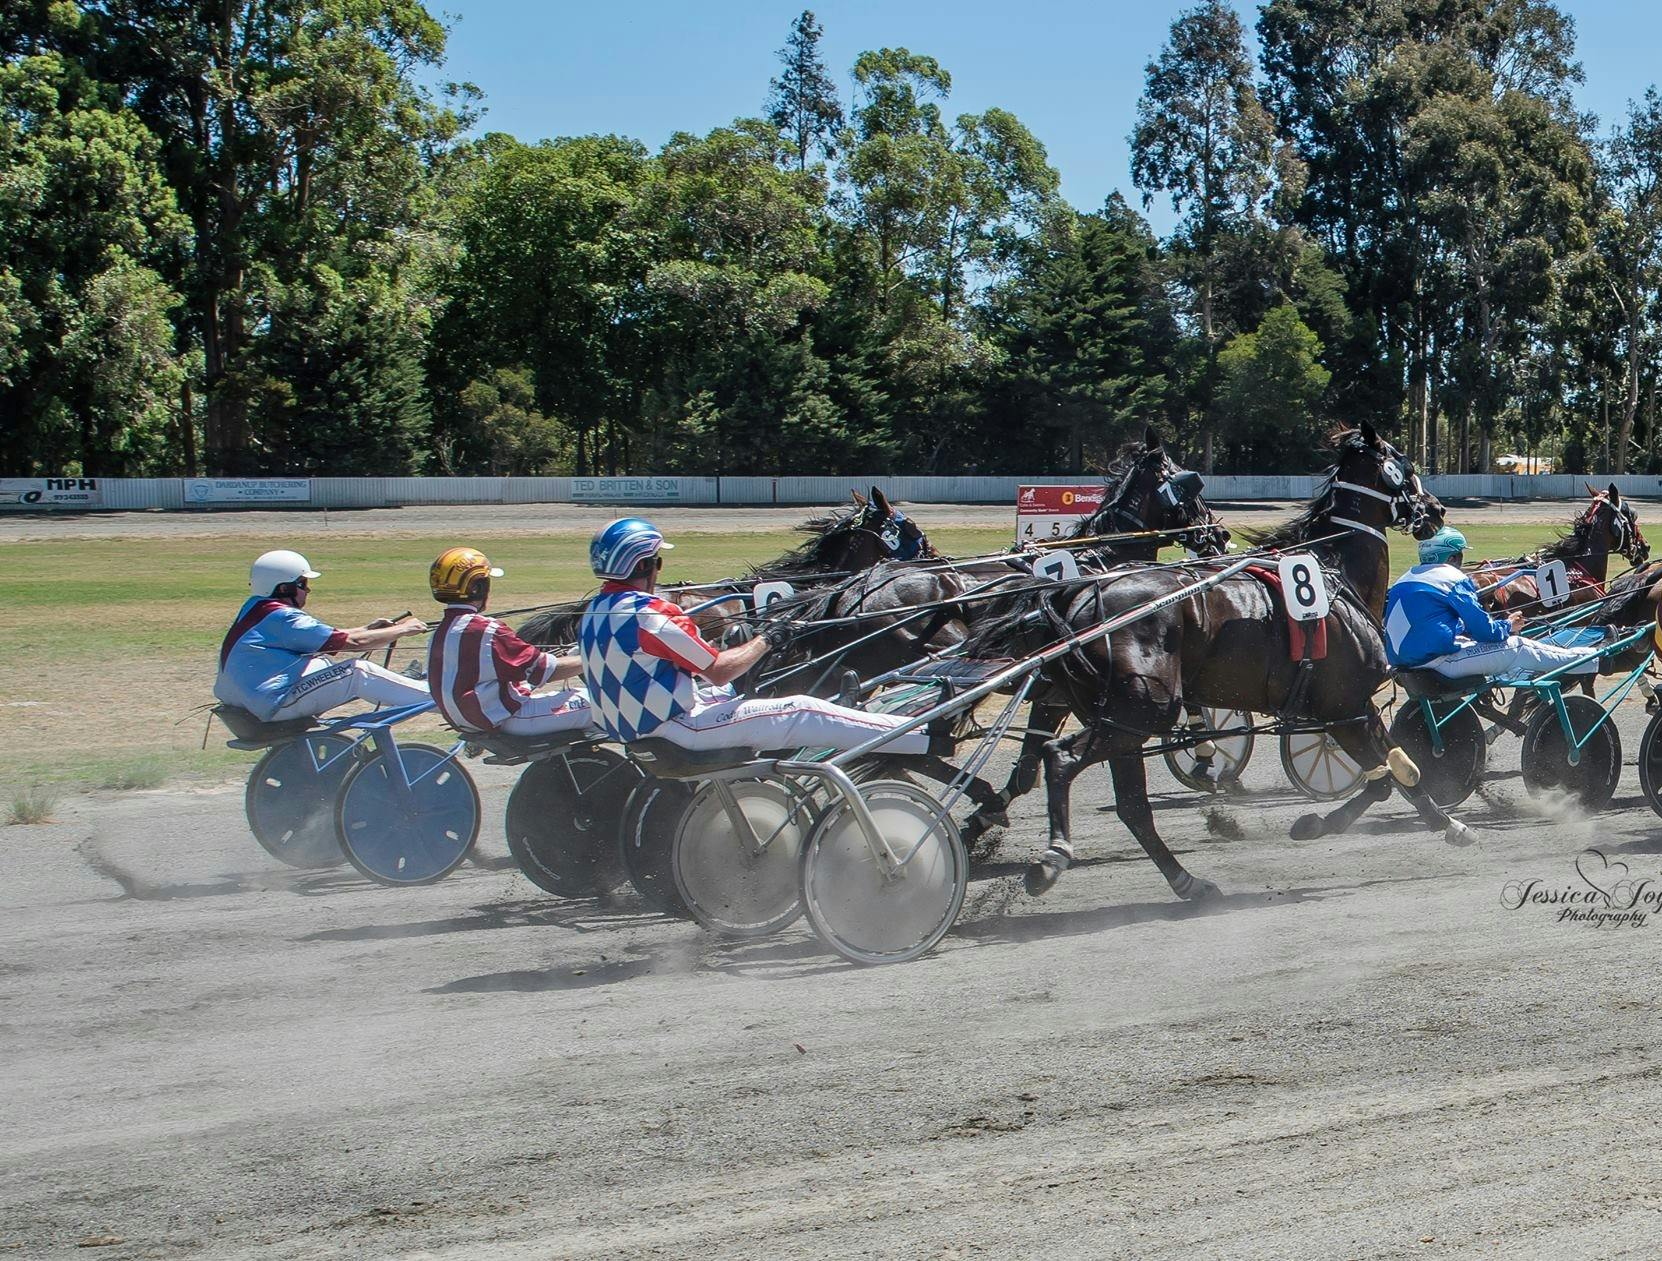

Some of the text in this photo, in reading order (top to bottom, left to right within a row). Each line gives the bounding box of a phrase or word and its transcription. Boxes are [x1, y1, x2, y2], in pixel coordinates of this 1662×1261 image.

[1383, 460, 1404, 486] 8
[47, 478, 97, 491] MPH
[574, 479, 678, 491] TED BRITTEN & SON
[1157, 481, 1179, 507] 7
[1075, 493, 1105, 504] Bendig
[1025, 522, 1060, 537] 4 5
[1044, 560, 1064, 580] 7
[1292, 563, 1317, 607] 8
[1545, 568, 1558, 597] 1
